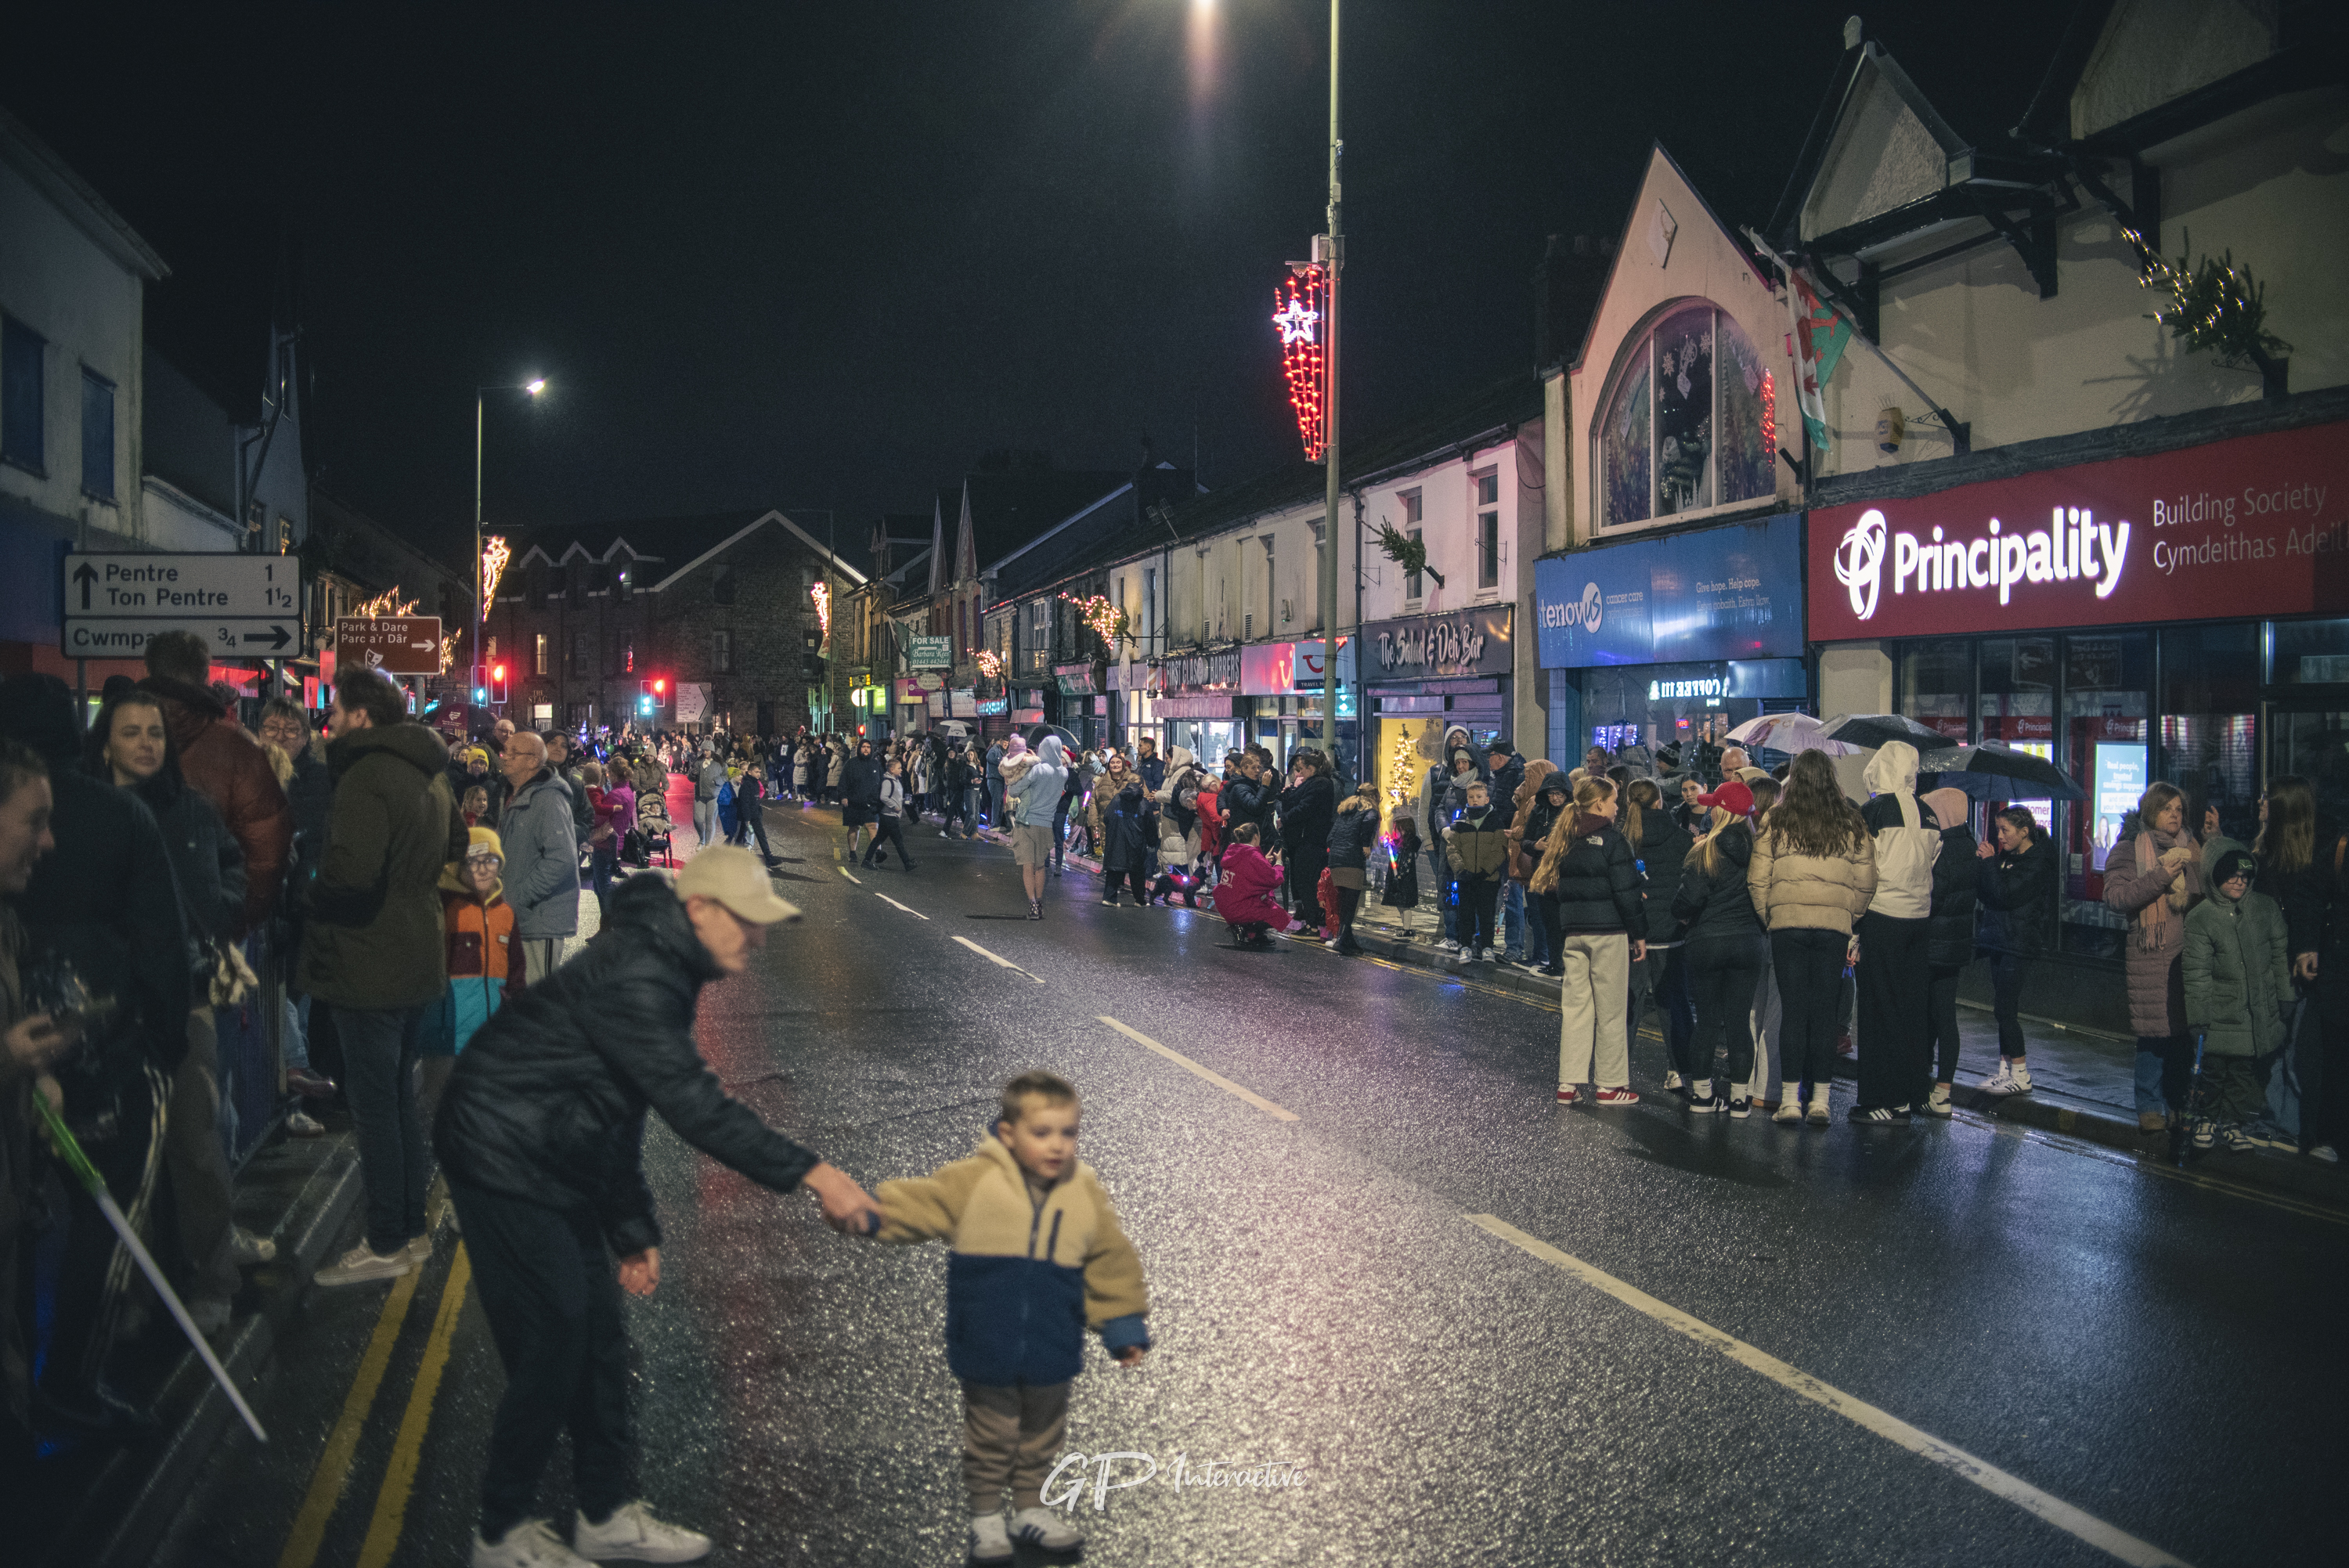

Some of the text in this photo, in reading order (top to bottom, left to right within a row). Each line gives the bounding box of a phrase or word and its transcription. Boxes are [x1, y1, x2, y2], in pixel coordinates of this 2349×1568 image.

[2153, 482, 2326, 527] Building Society
[1894, 506, 2131, 606] Principality
[2153, 521, 2349, 575] Cymdeithas Adeil
[106, 564, 272, 582] Pentre 1
[1696, 578, 1761, 593] Give hope. Help cope.
[107, 588, 146, 606] Ton
[157, 588, 229, 606] Pentre
[1606, 592, 1644, 604] cancer care
[1540, 591, 1601, 629] tenovus
[341, 622, 408, 632] Park & Dare
[73, 628, 157, 650] Cwmpa
[341, 634, 366, 643] Parc
[388, 633, 407, 643] Dâr
[1377, 623, 1484, 670] The Salad & Deli Bar
[912, 648, 950, 658] Barbara Rees
[1166, 654, 1239, 686] FIRST CLAS BARBERS
[2025, 722, 2052, 734] Principalit
[2119, 762, 2140, 772] people,
[2123, 783, 2144, 792] support
